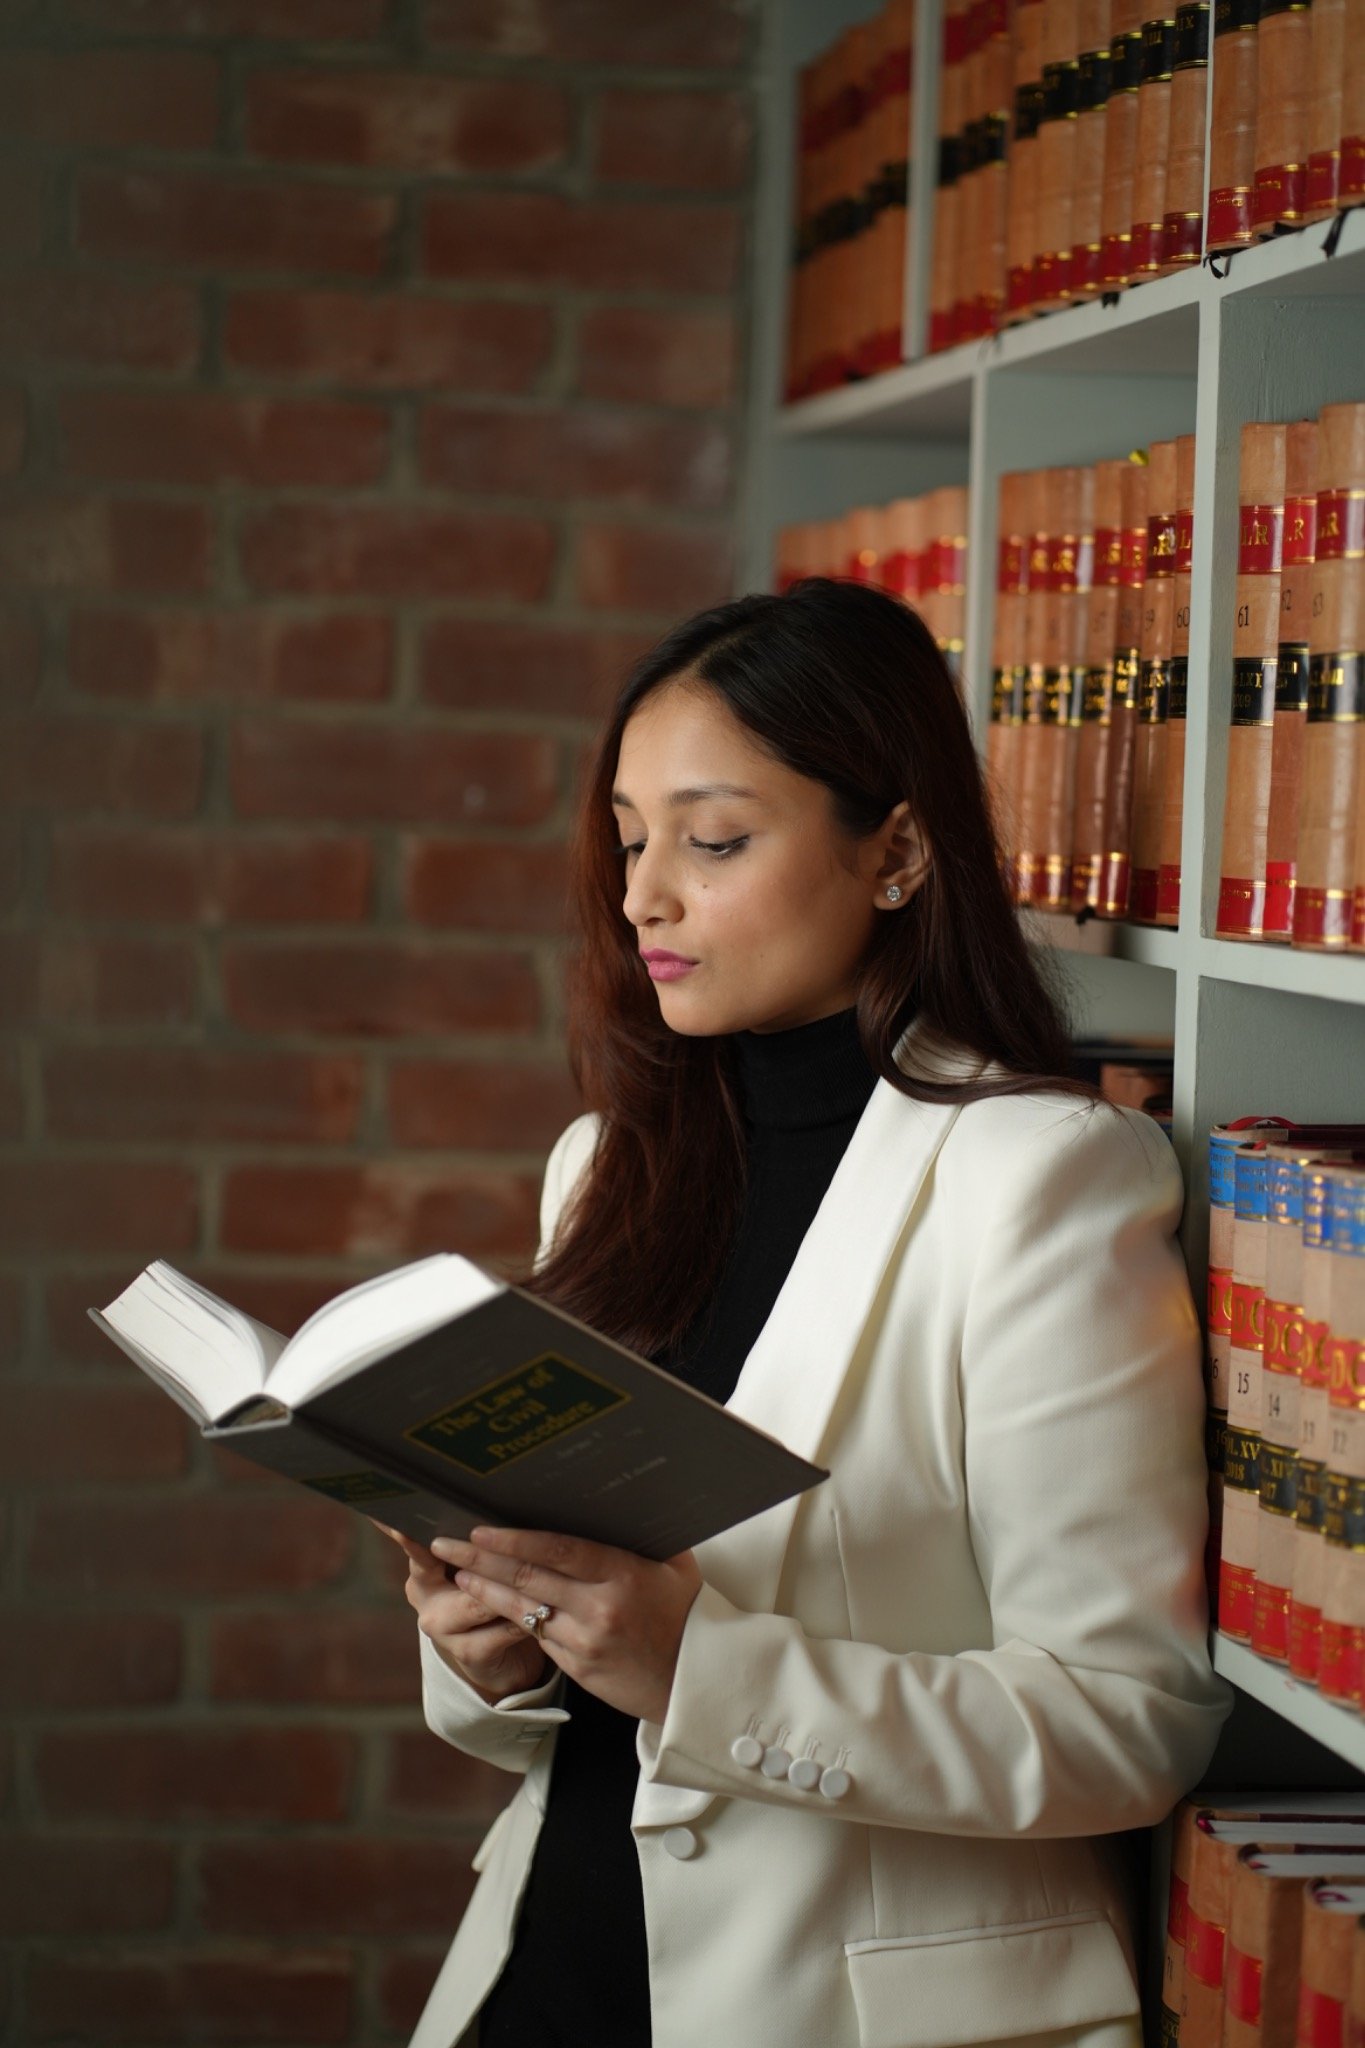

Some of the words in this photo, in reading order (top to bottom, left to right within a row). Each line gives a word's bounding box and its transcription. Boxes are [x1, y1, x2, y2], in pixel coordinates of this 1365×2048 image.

[1176, 606, 1191, 629] 60
[1237, 605, 1250, 628] 61
[1237, 1371, 1250, 1395] 15
[429, 1410, 482, 1437] The
[473, 1384, 527, 1415] Law
[526, 1366, 555, 1390] of
[1268, 1393, 1281, 1418] 14
[487, 1396, 548, 1434] Civil
[485, 1401, 597, 1460] Procedure
